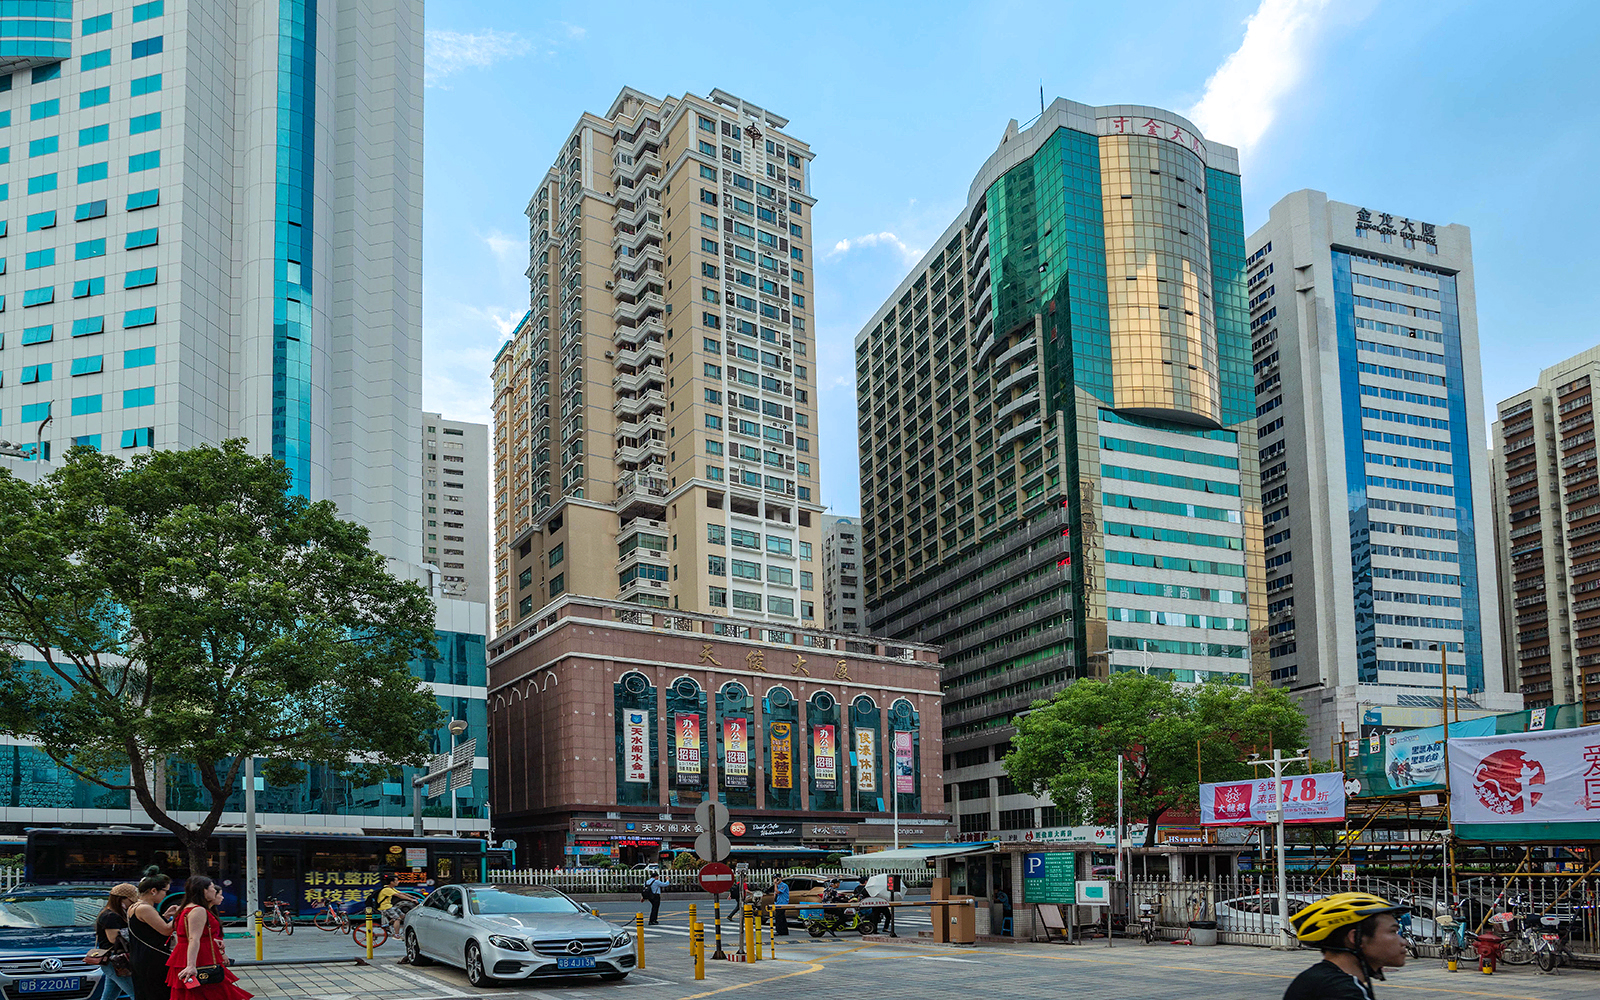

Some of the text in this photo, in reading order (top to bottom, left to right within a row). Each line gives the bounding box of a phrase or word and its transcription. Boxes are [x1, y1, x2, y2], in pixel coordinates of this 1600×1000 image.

[1356, 207, 1436, 239] 金龙大厦
[679, 749, 699, 761] 招租
[727, 752, 746, 763] 招租
[816, 757, 833, 768] 招租
[1028, 857, 1041, 873] P
[305, 871, 380, 886] 非凡整形
